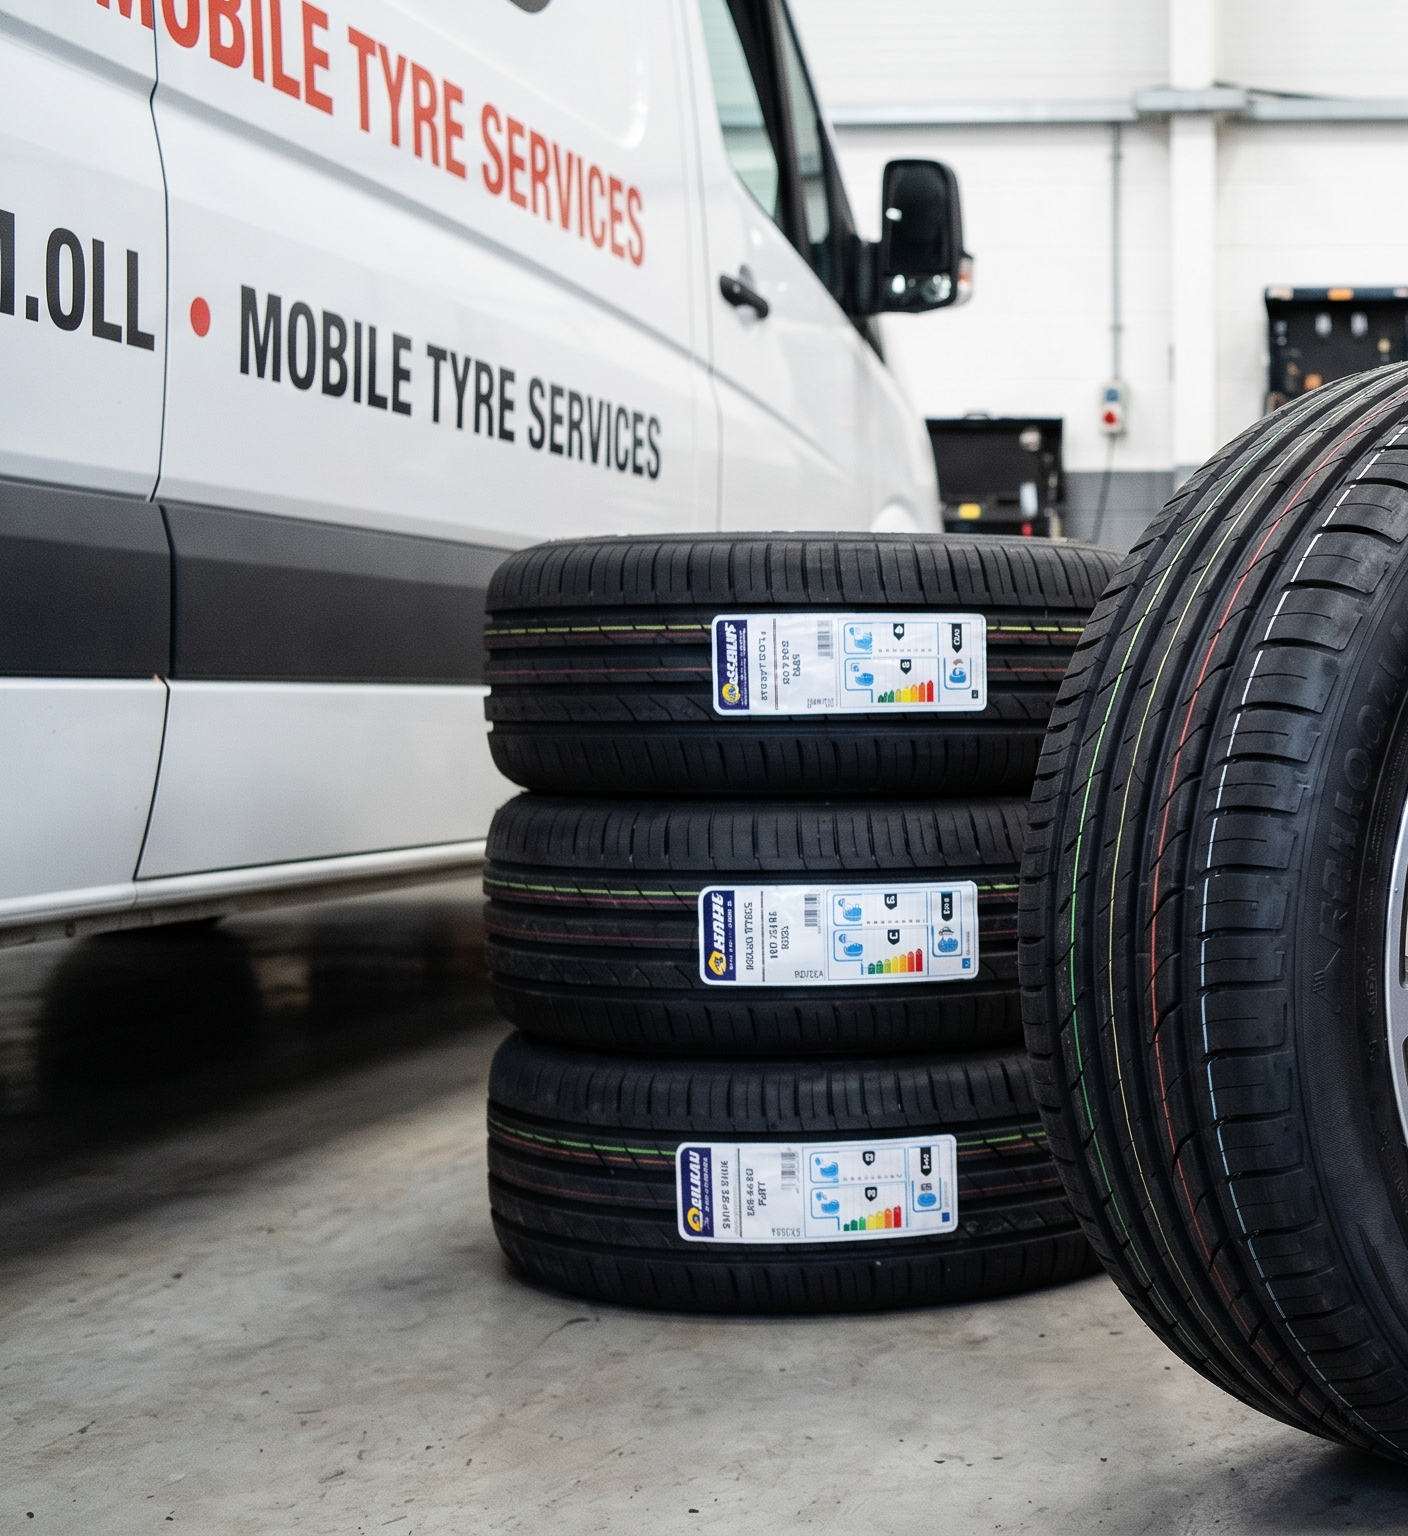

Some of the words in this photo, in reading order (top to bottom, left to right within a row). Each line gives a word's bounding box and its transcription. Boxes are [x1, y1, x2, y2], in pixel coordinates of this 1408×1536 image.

[96, 0, 333, 115] BILE
[347, 26, 467, 179] TYRE
[481, 103, 645, 268] SERVICES
[240, 285, 412, 416] MOBILE
[427, 344, 516, 443] TYRE
[528, 378, 661, 481] SERVICES
